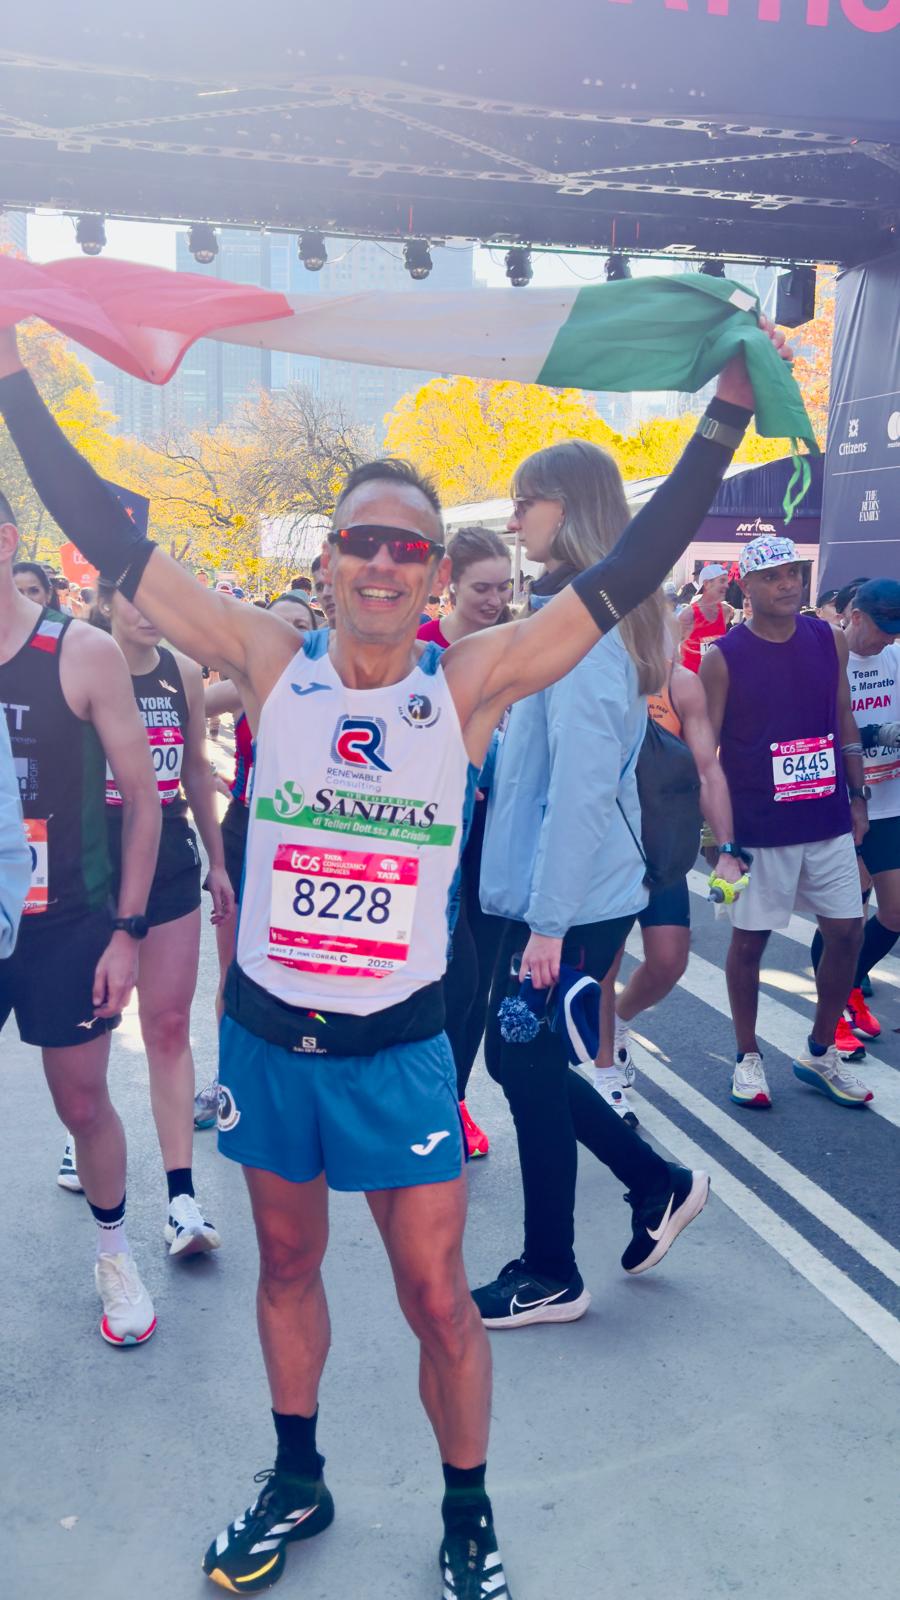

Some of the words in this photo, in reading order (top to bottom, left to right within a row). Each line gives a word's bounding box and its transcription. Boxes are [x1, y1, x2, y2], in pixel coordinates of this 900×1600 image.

[838, 441, 867, 456] Citizens
[865, 490, 878, 501] THE
[852, 669, 878, 680] Team
[139, 697, 173, 710] YORK
[851, 694, 892, 712] JAPAN
[782, 751, 829, 776] 6445
[326, 767, 383, 784] RENEWABLE
[794, 771, 820, 783] NATE
[325, 776, 382, 793] Consulting
[311, 788, 439, 829] SANITAS
[312, 816, 321, 826] di
[323, 818, 351, 831] Telleri
[290, 850, 321, 872] tcs
[323, 853, 343, 861] TATA
[321, 867, 351, 876] SERVICES
[322, 860, 367, 871] CONSULTANCY
[376, 871, 400, 881] TATA
[292, 878, 392, 925] 8228
[311, 952, 338, 961] CORRAL
[339, 954, 348, 963] C
[367, 958, 394, 969] 2025
